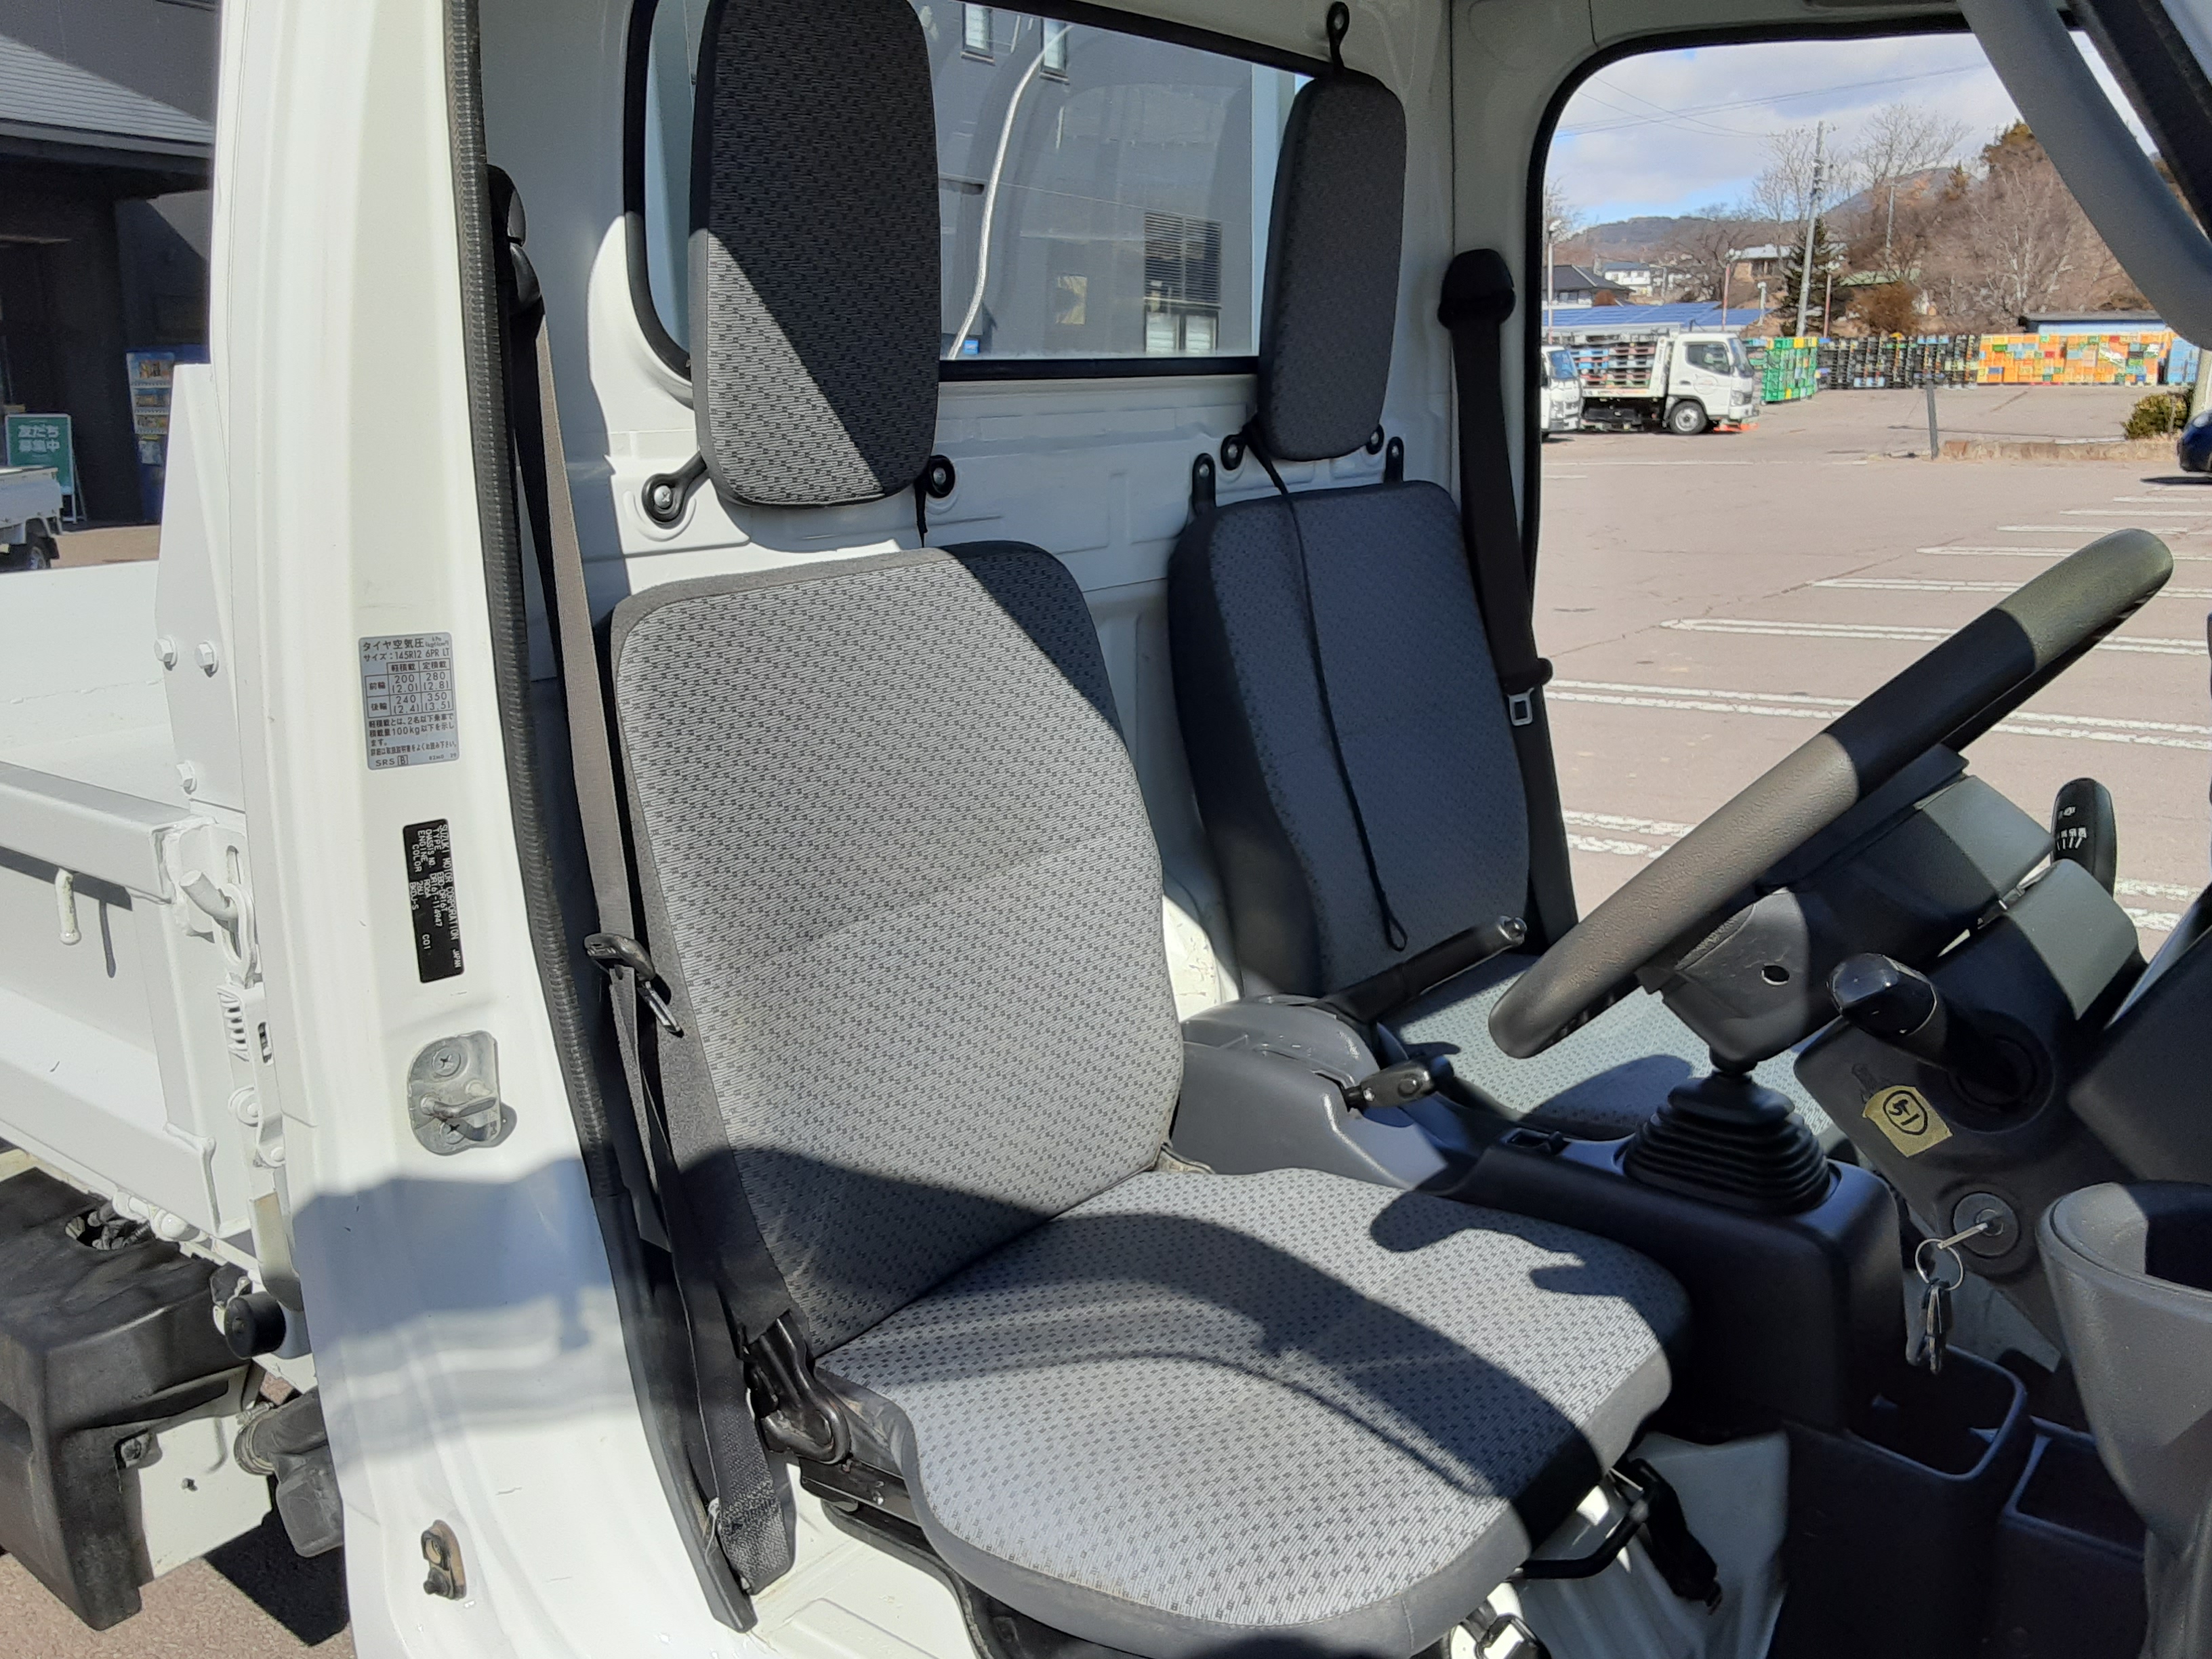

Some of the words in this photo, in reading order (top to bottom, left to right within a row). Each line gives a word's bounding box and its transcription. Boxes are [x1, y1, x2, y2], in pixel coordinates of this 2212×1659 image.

[363, 638, 424, 651] タイヤ空気圧
[426, 649, 440, 657] 6PR
[443, 648, 450, 657] LT
[394, 674, 415, 684] 200
[426, 672, 445, 681] 280
[392, 683, 418, 693] (2.0)
[424, 680, 449, 691] (2.8)
[396, 695, 416, 704] 240
[428, 692, 447, 701] 350
[394, 703, 419, 714] (2.4)
[425, 701, 450, 712] (3.5)
[375, 758, 395, 766] SRS
[426, 829, 435, 855] CHASSIS
[439, 824, 450, 853] SUZUKI
[418, 830, 428, 863] ENGINE
[412, 844, 422, 872] COLOR
[433, 828, 441, 851] TYPE
[437, 872, 448, 912] EBD-DR16T
[443, 857, 453, 883] MOTOR
[445, 886, 459, 940] CORPORATION
[453, 949, 462, 968] JAPAN
